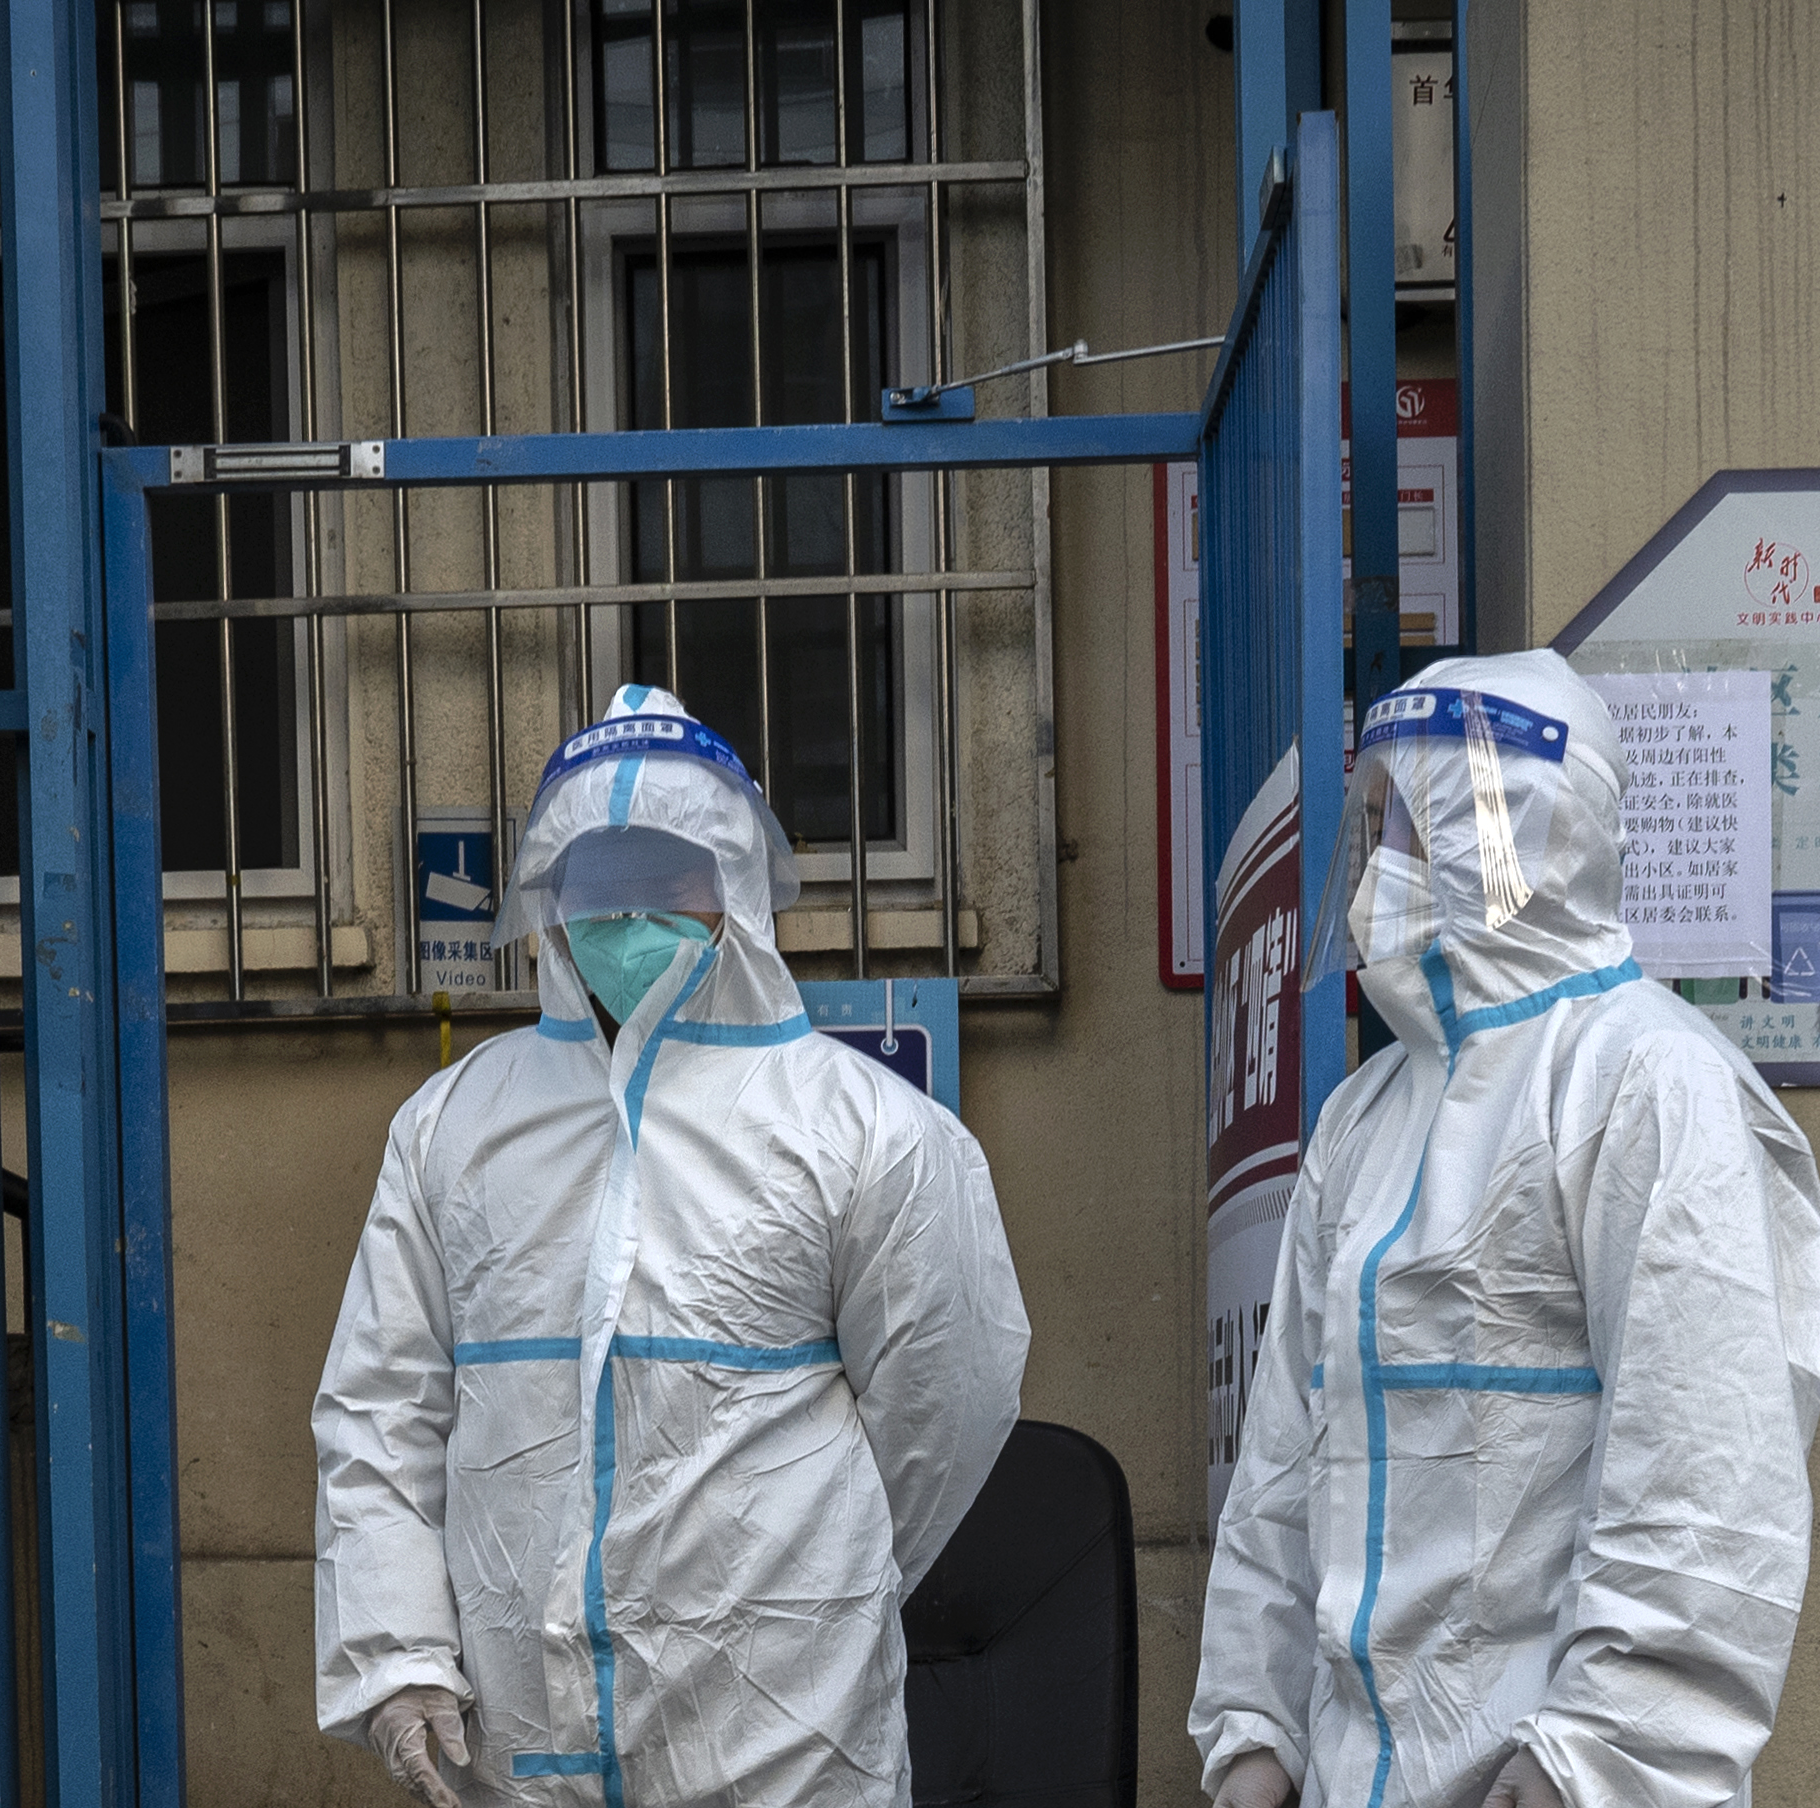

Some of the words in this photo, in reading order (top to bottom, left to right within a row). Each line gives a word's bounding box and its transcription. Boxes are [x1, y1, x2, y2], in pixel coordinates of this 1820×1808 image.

[1618, 792, 1738, 813] 证安全，除就医
[1618, 904, 1738, 924] 区居委会联系。
[437, 970, 486, 987] Video
[1741, 1033, 1803, 1051] 文明健康
